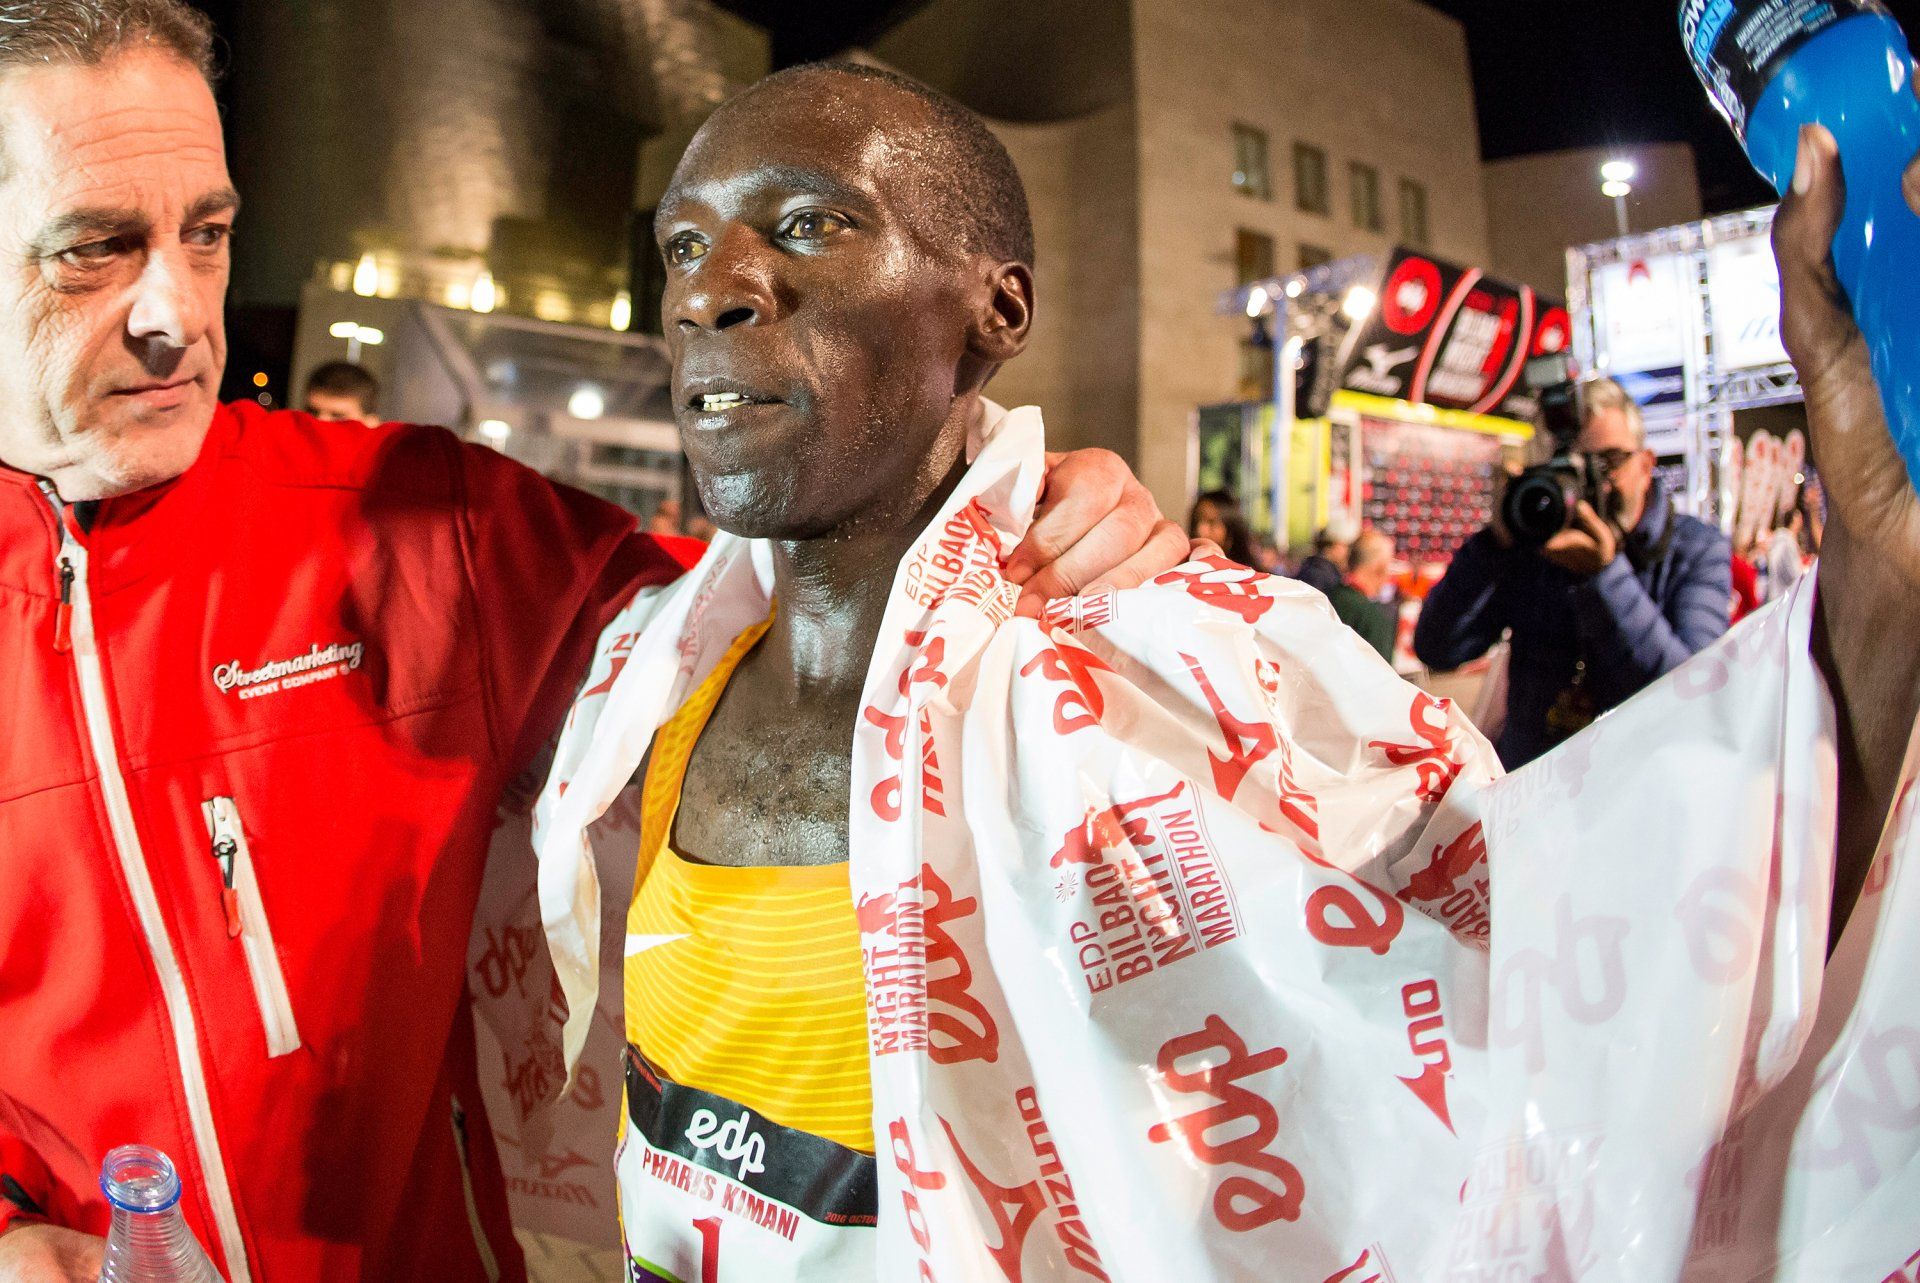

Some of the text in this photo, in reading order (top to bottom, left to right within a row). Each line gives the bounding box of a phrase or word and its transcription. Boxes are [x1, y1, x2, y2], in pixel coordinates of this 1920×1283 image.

[212, 642, 363, 694] Streetmarketing
[238, 667, 338, 700] EVENT COMPANY
[1160, 809, 1237, 949] MARATHON
[1069, 921, 1113, 993] EDP
[1084, 863, 1154, 984] BILBAO
[684, 1108, 765, 1181] edp
[642, 1147, 717, 1202] PHARIS
[721, 1182, 800, 1242] KIMANI
[692, 1214, 723, 1283] 1
